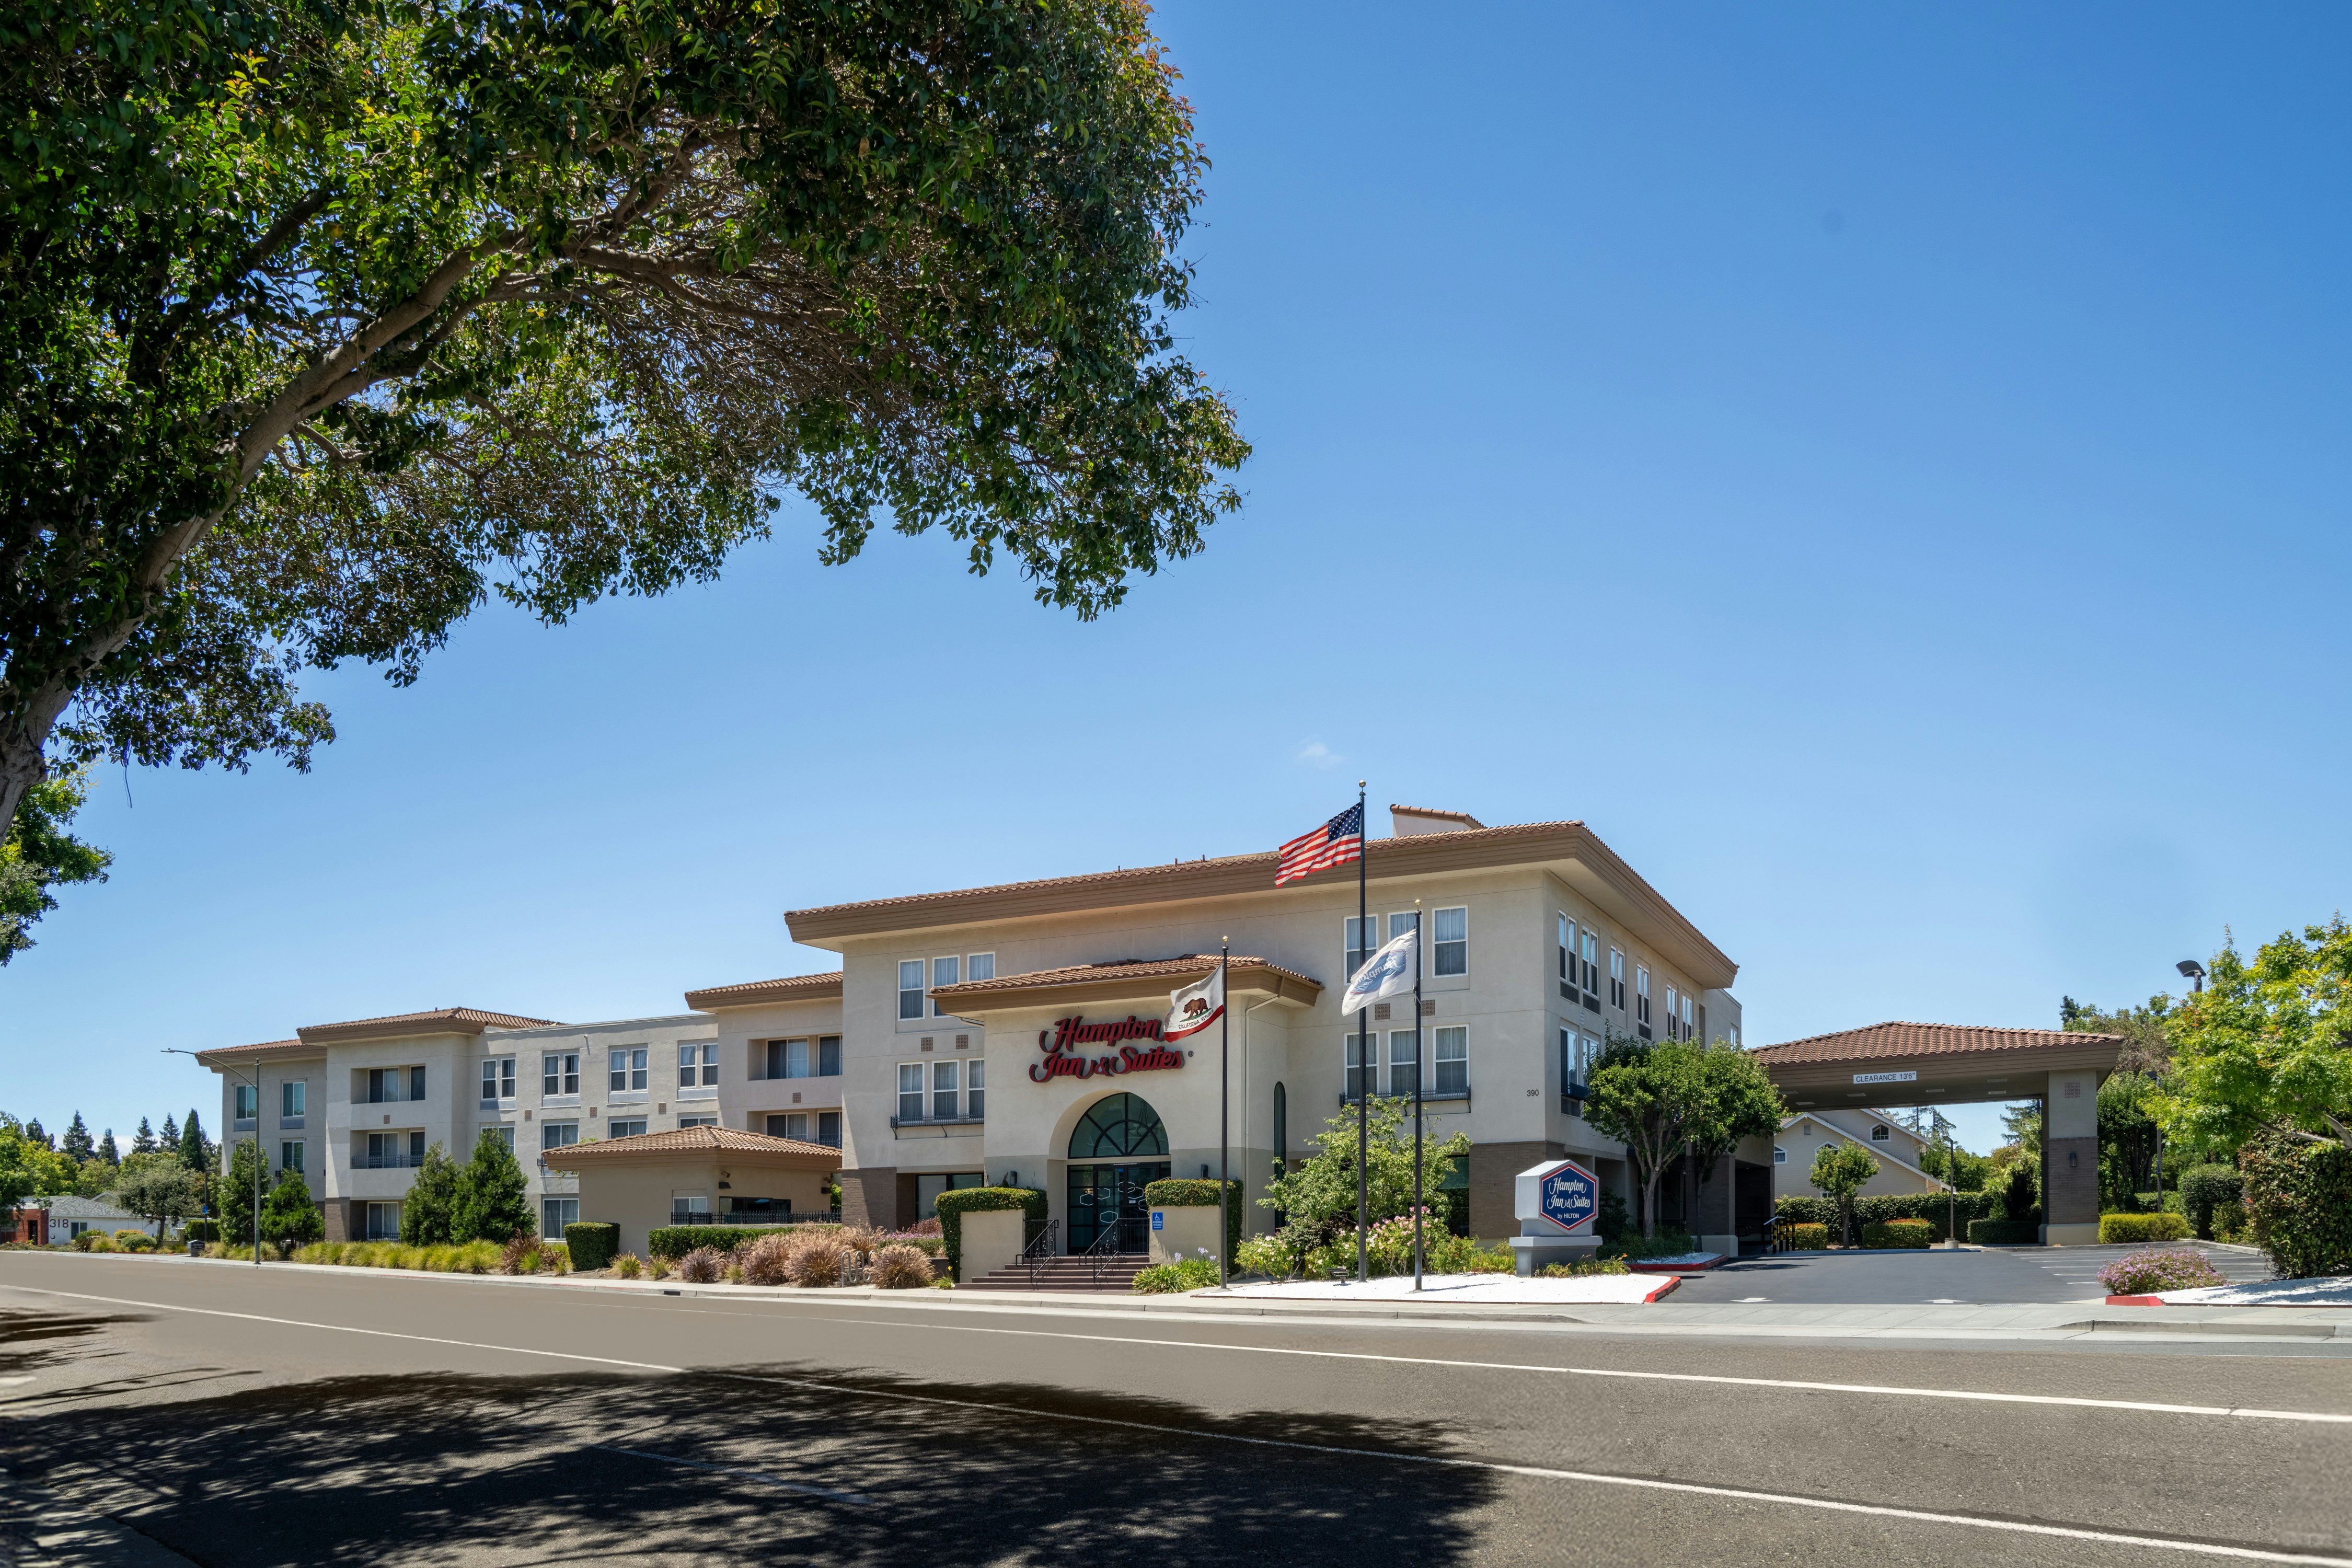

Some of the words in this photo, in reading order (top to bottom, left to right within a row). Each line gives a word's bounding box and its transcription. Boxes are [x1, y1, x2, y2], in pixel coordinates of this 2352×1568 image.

[1178, 1020, 1200, 1030] CALIFORNIA
[1201, 1008, 1214, 1022] REPUBLIC
[1039, 1015, 1166, 1054] Hampton
[1029, 1053, 1097, 1083] Inn
[1094, 1056, 1115, 1077] &
[1109, 1046, 1185, 1075] Suites
[1856, 1074, 1897, 1082] CLEARANCE
[1549, 1177, 1587, 1195] Hampton
[1547, 1194, 1568, 1209] Inn
[1566, 1198, 1572, 1209] &
[1570, 1194, 1590, 1208] Suites
[49, 1218, 69, 1228] 318
